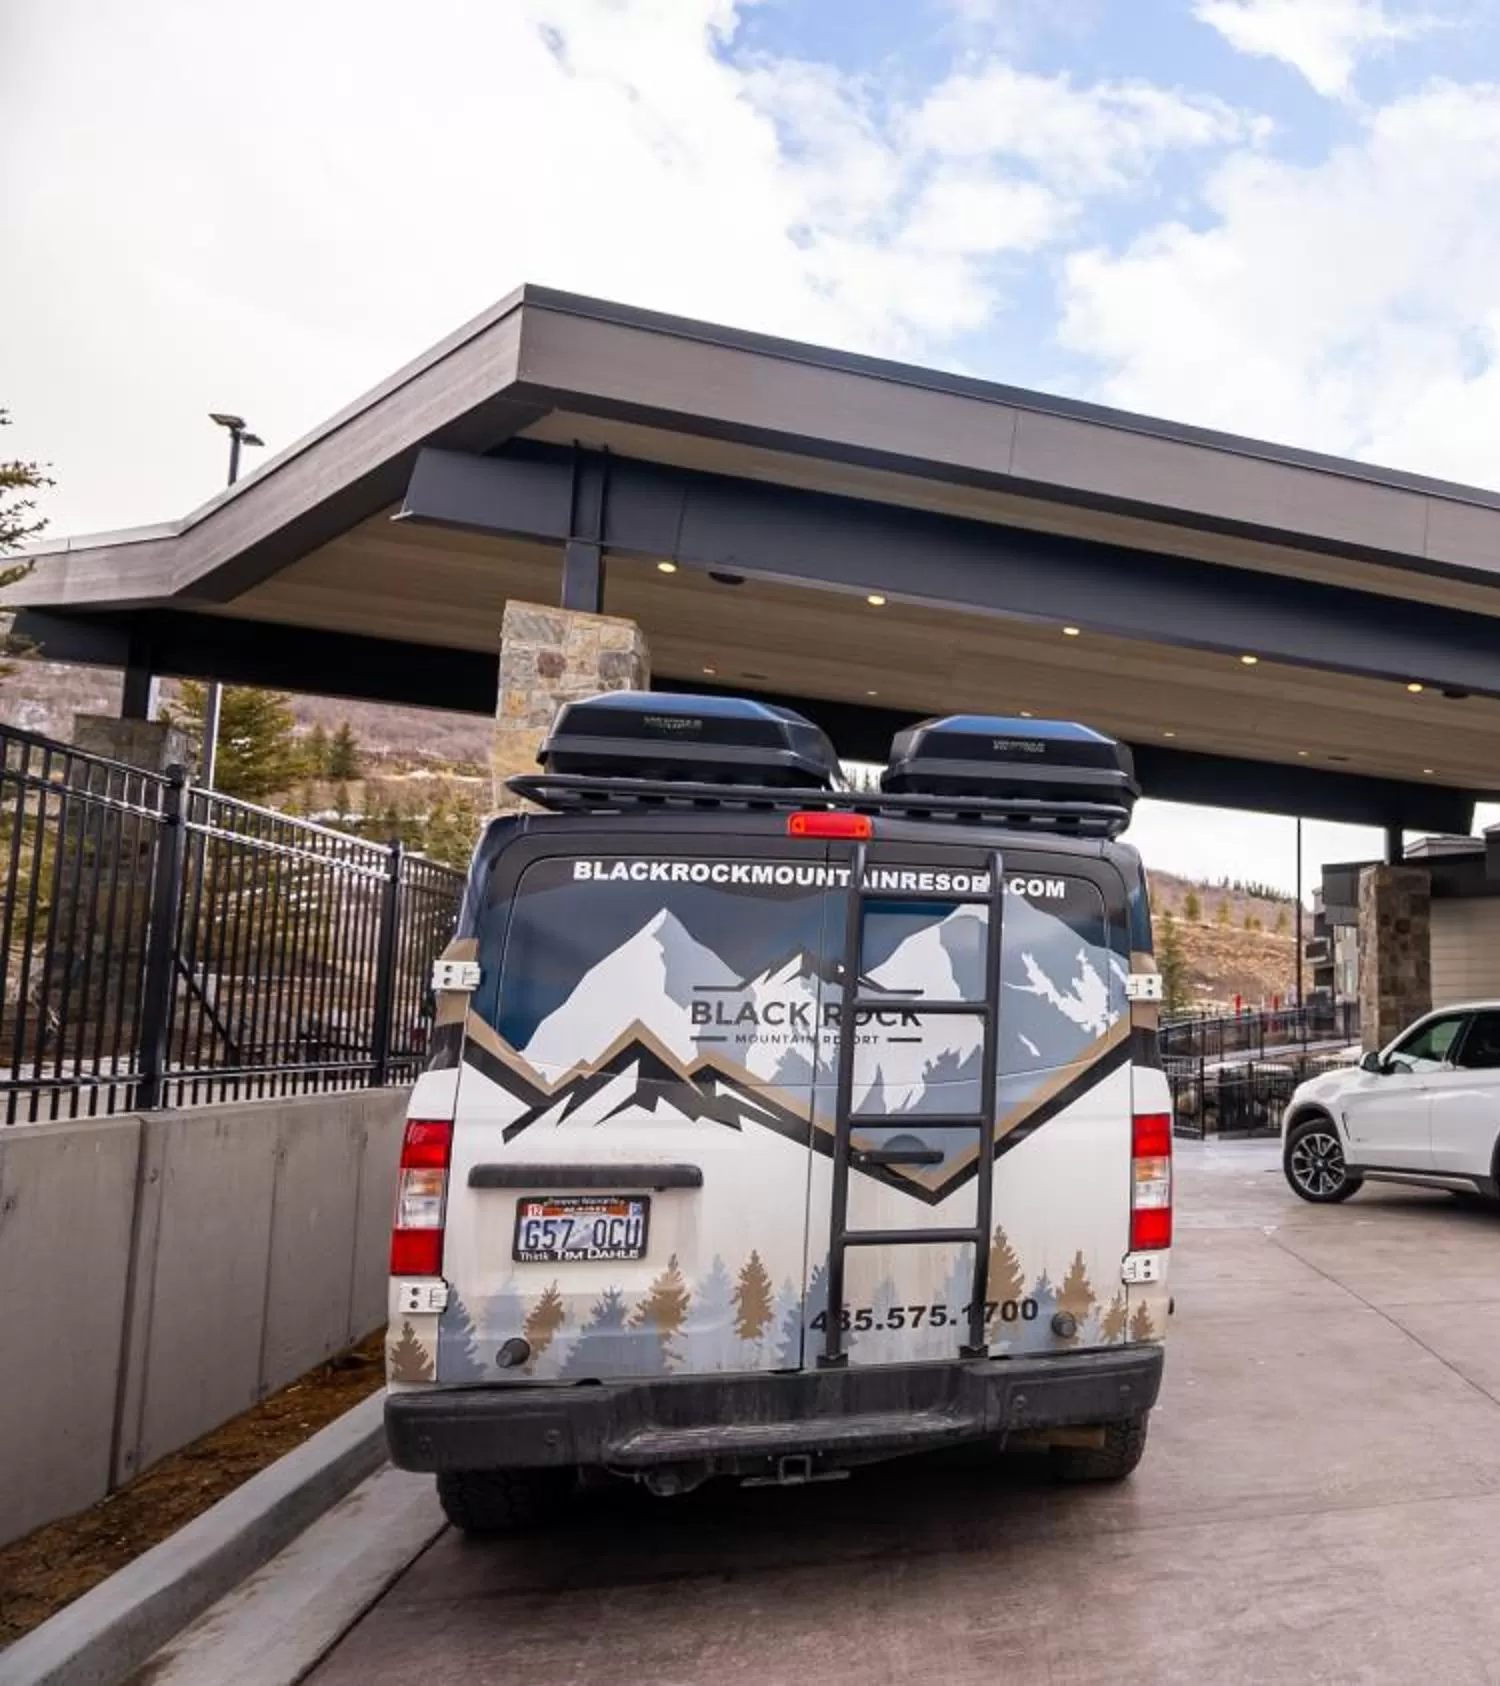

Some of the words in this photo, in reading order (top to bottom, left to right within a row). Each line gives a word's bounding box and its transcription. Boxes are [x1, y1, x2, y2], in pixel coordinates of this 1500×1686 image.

[691, 1002, 811, 1026] BLACK
[735, 1033, 817, 1045] MOUNTAIN
[525, 1219, 575, 1249] G57
[554, 1249, 583, 1260] TIM
[587, 1248, 639, 1260] DAHLE
